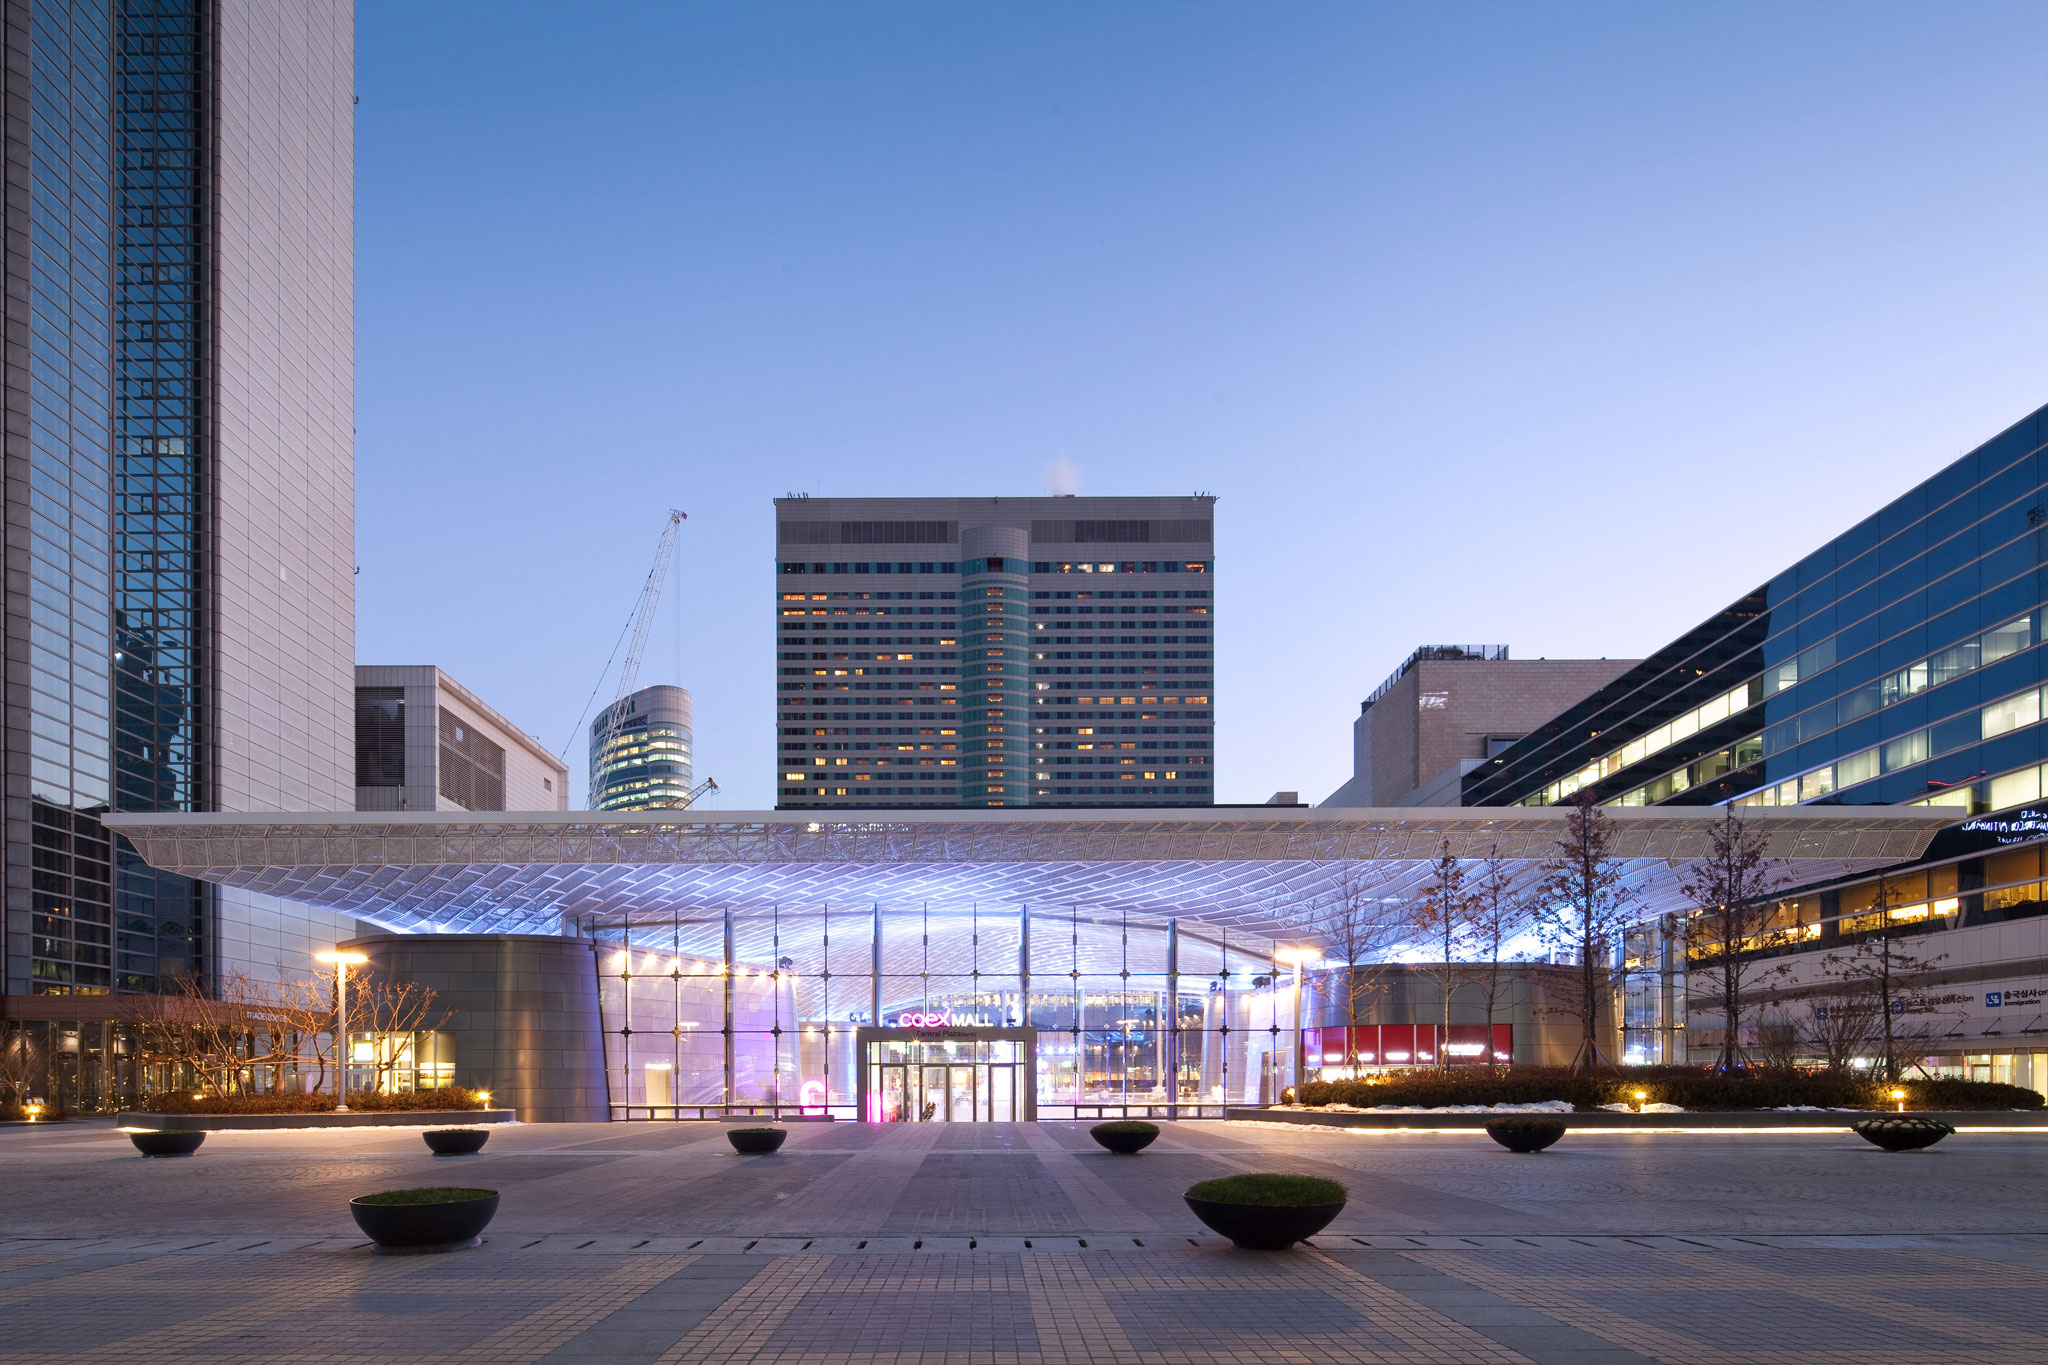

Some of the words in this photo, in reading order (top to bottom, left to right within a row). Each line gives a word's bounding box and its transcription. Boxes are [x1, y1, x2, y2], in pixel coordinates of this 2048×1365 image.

[246, 1011, 265, 1020] TRADE
[951, 1013, 995, 1027] MALL
[916, 1030, 941, 1038] Central
